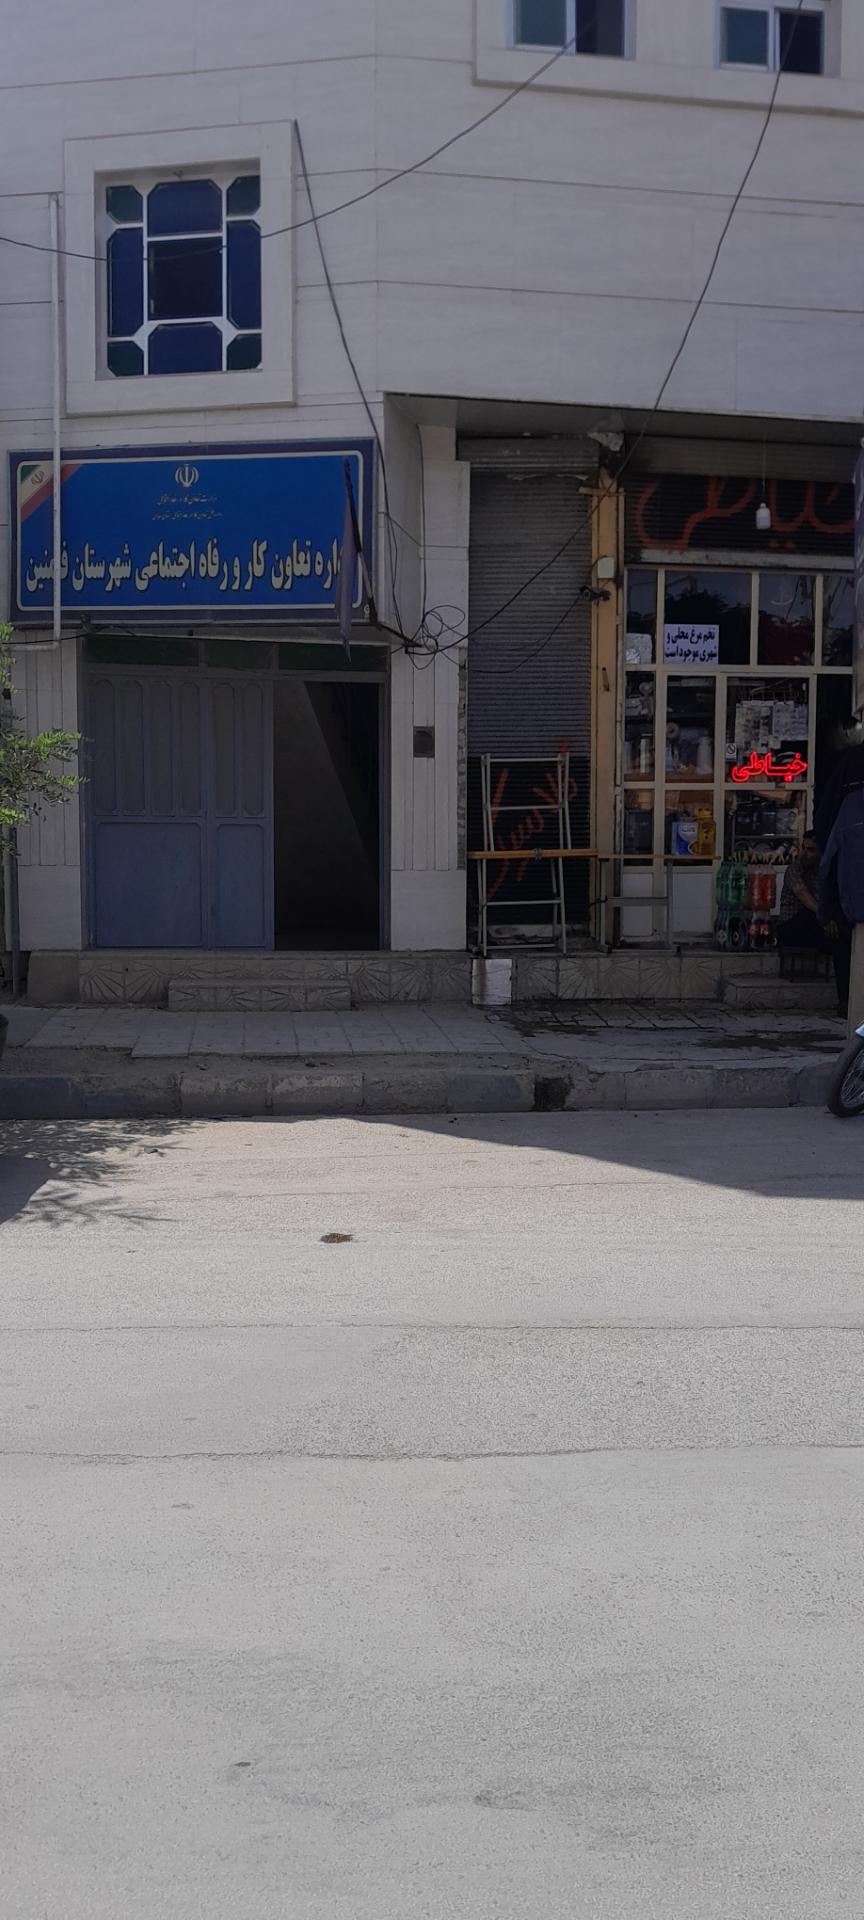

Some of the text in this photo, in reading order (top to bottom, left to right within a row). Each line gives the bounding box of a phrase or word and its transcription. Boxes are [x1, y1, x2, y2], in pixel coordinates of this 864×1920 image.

[72, 543, 132, 591] شهرستان
[135, 540, 196, 591] اجتماعی
[199, 537, 228, 591] رفاه
[231, 556, 241, 591] و
[244, 539, 268, 591] کار
[271, 538, 312, 590] تعاون
[314, 537, 343, 591] اره
[665, 645, 717, 662] شهری موجود است
[666, 632, 671, 643] و
[671, 627, 689, 643] محلی
[690, 626, 703, 644] مرغ
[731, 751, 808, 783] خیاطی
